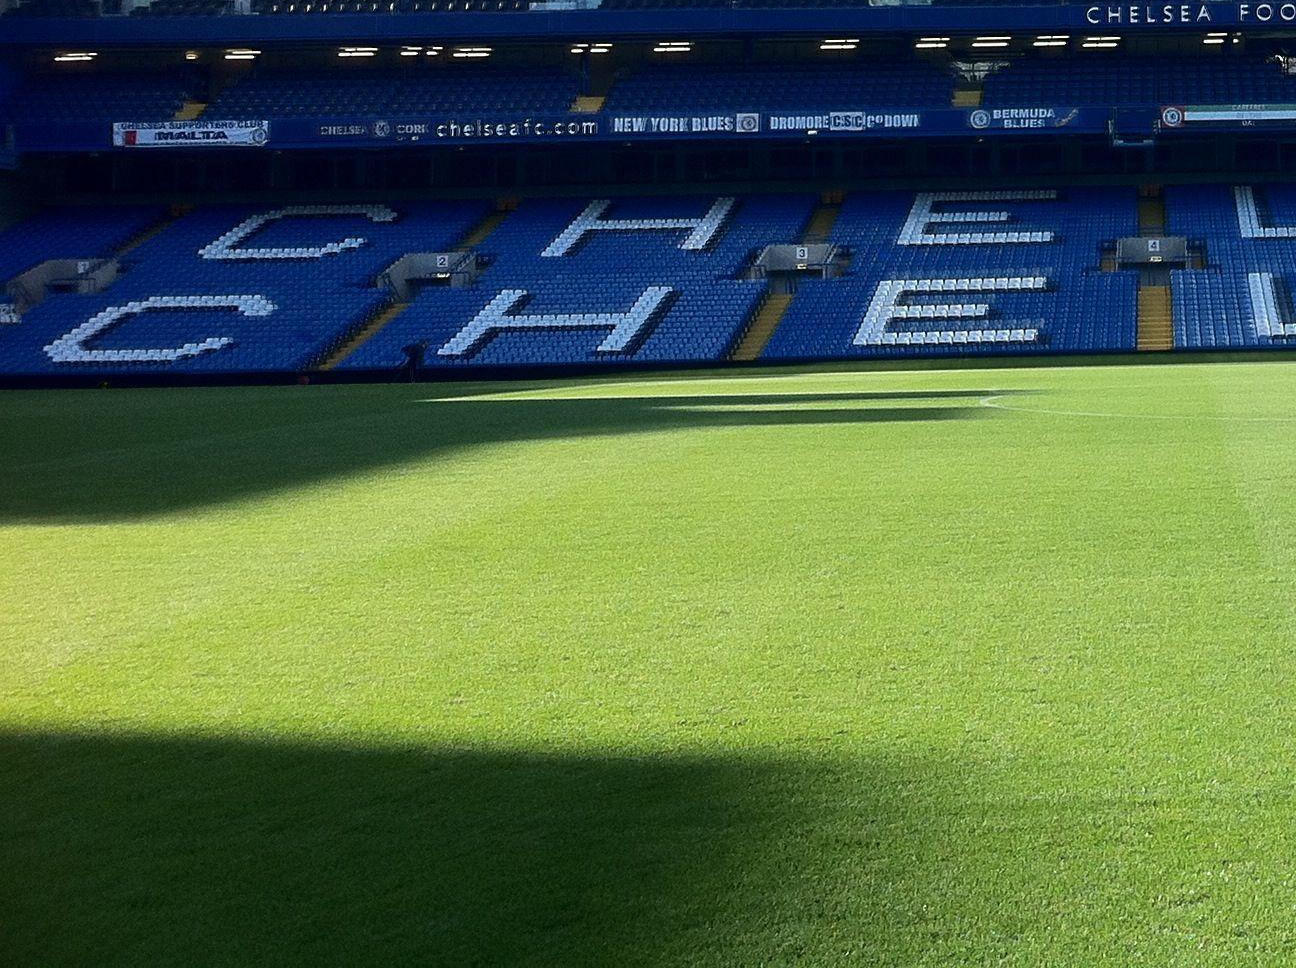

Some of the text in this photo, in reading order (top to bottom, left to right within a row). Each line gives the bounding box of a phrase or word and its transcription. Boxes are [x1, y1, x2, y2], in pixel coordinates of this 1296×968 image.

[1086, 4, 1211, 23] CHELSEA
[770, 115, 829, 129] DROMORE
[884, 114, 920, 127] DOWN
[993, 109, 1056, 119] BERMUDA
[436, 119, 598, 137] chelseafc.com
[614, 116, 734, 133] NEW YORK BLUES
[1004, 119, 1045, 128] BLUES
[154, 131, 228, 140] MALTA
